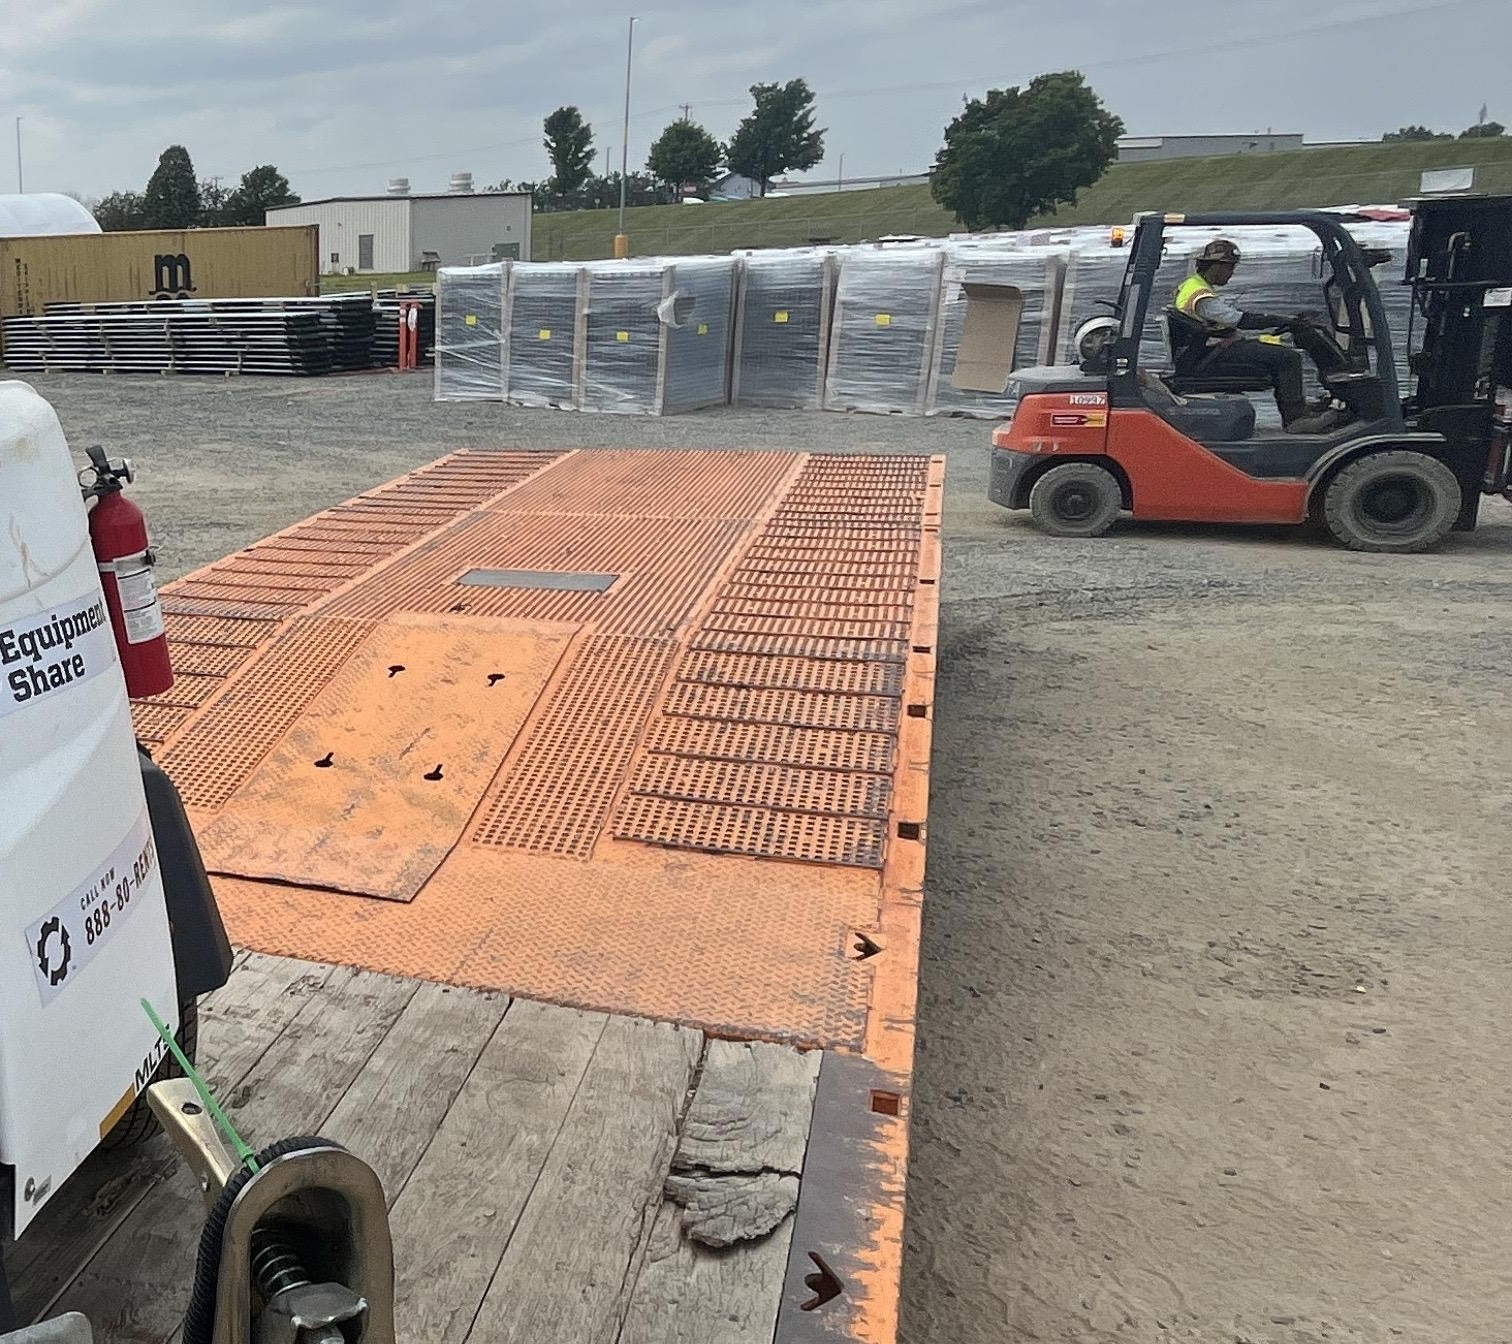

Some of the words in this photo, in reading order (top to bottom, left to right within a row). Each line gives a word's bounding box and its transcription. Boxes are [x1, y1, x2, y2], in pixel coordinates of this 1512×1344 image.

[8, 654, 86, 703] Share
[80, 885, 99, 910] CALL
[101, 867, 114, 892] NOW
